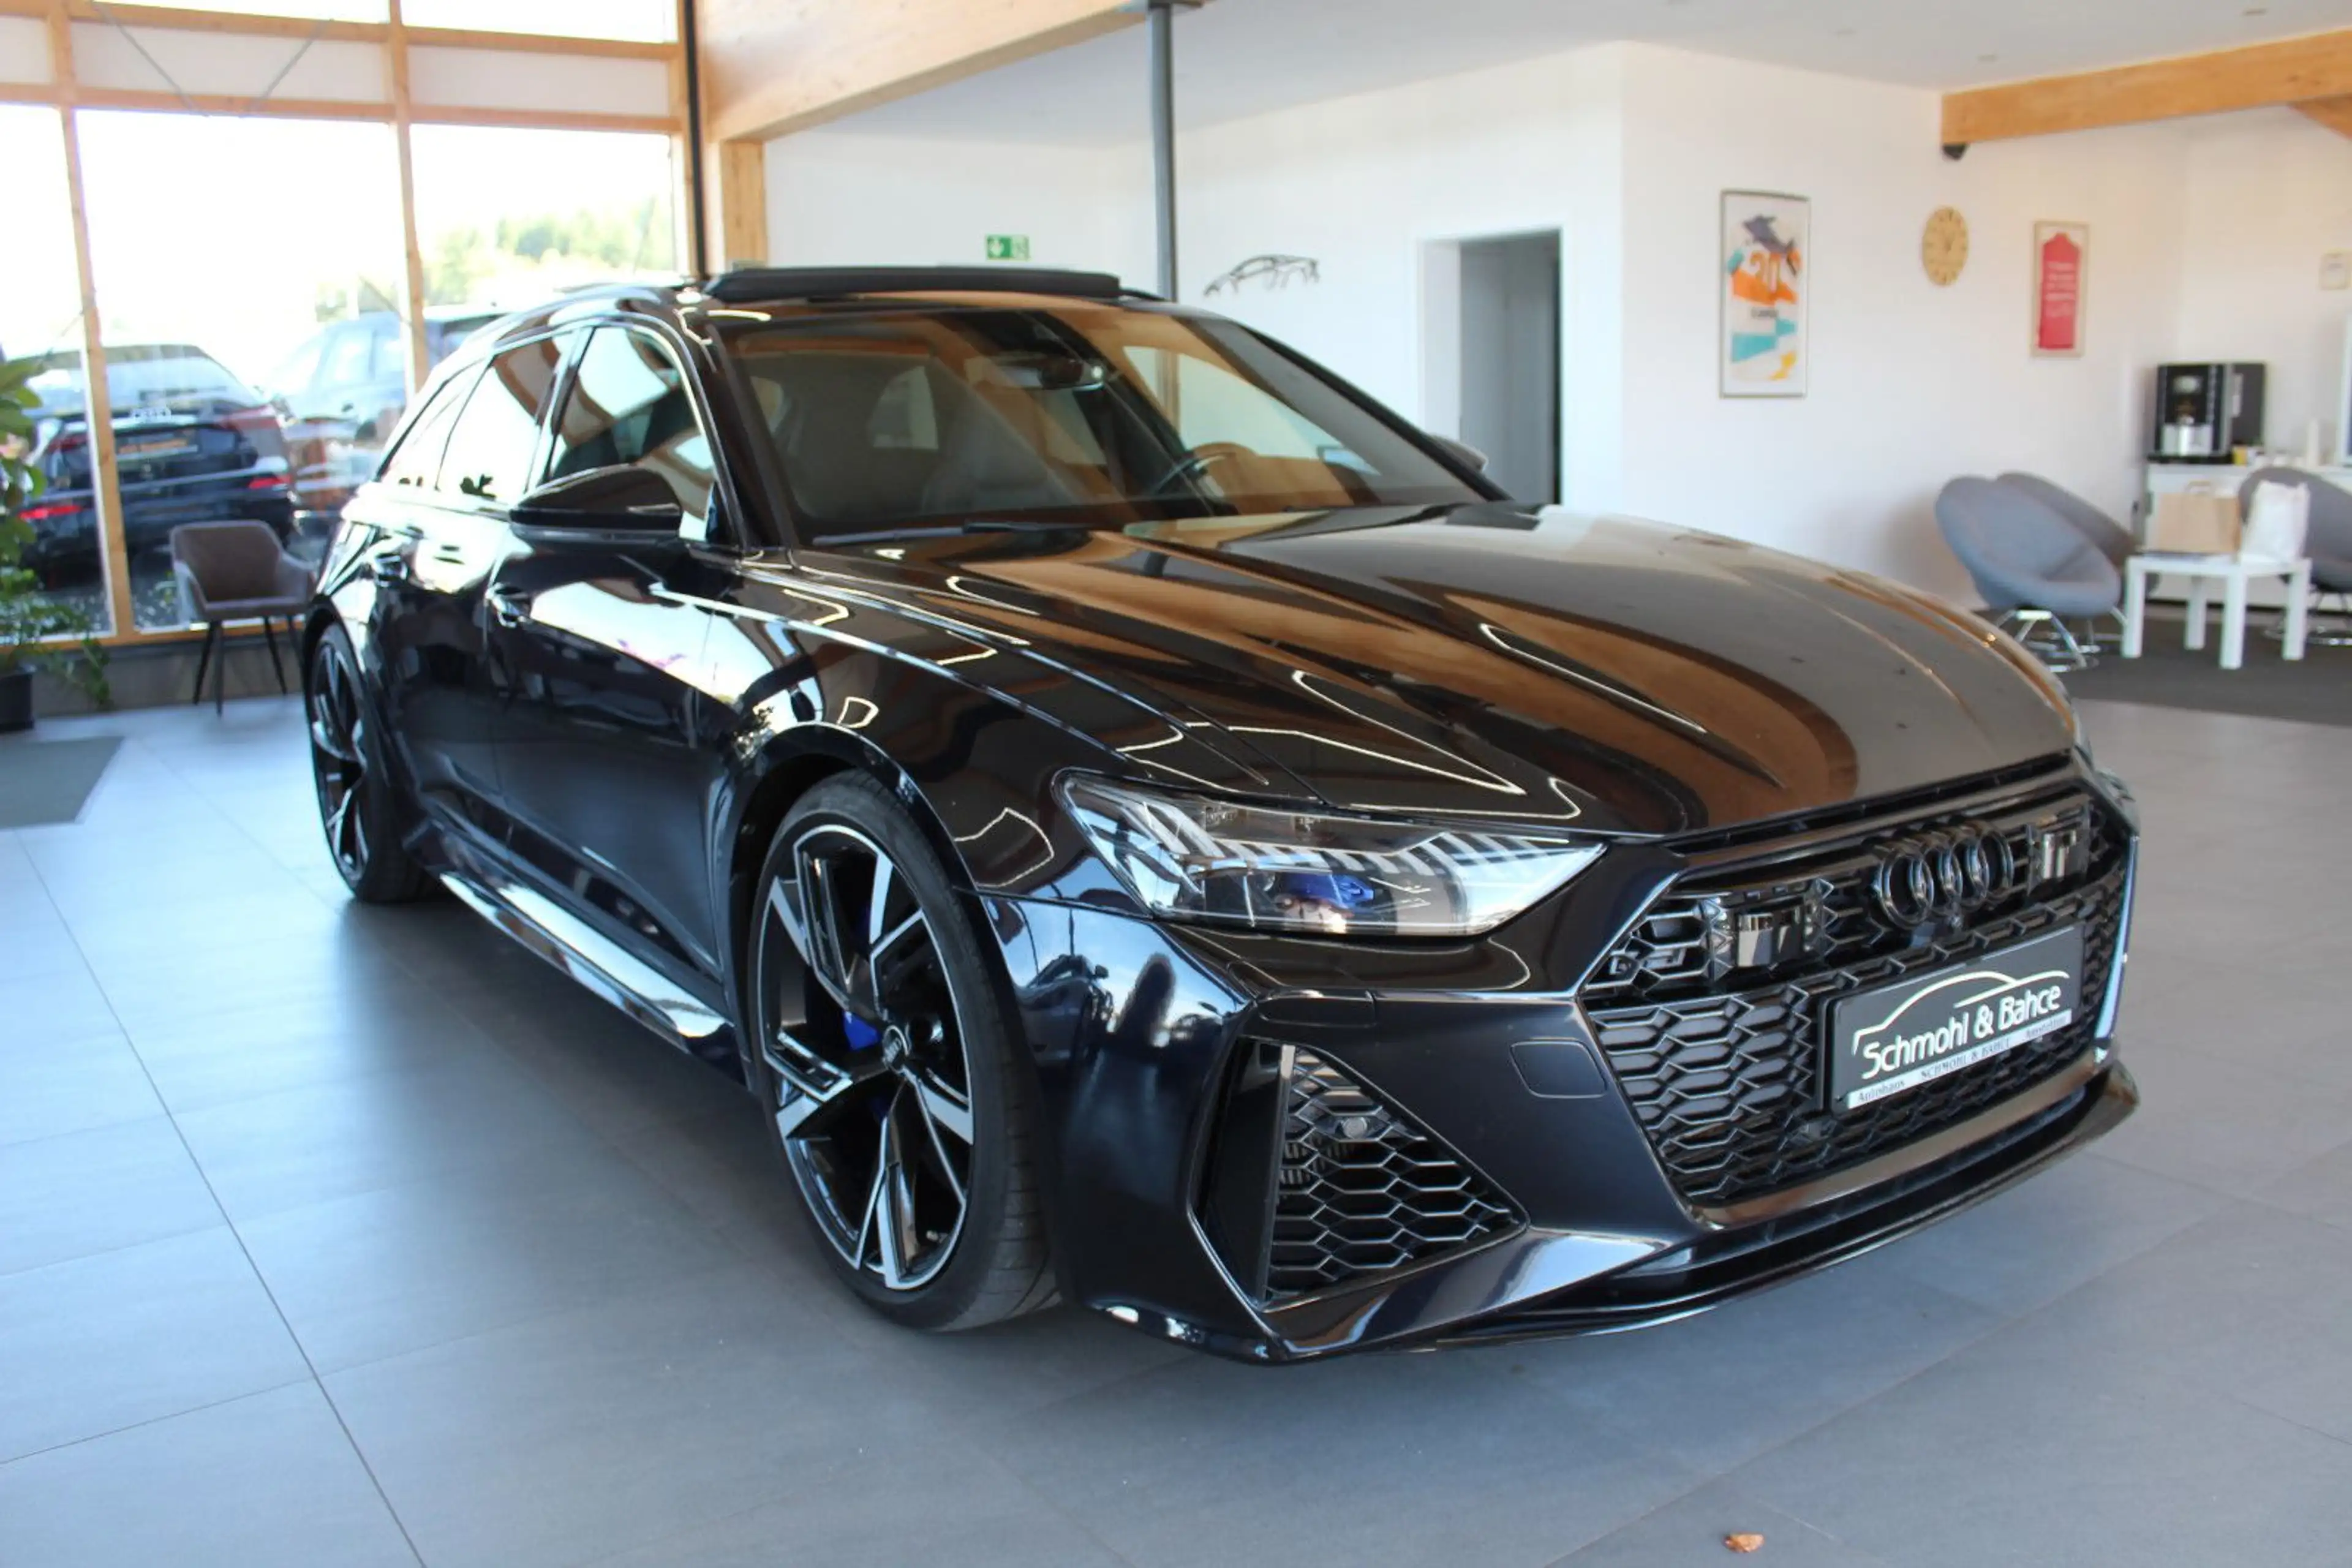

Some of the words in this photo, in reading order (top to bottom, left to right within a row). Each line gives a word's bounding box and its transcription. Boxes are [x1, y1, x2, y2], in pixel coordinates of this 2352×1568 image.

[1861, 1012, 1969, 1079] Schmohl
[1973, 1004, 1994, 1039] &
[1998, 985, 2061, 1030] Bahce
